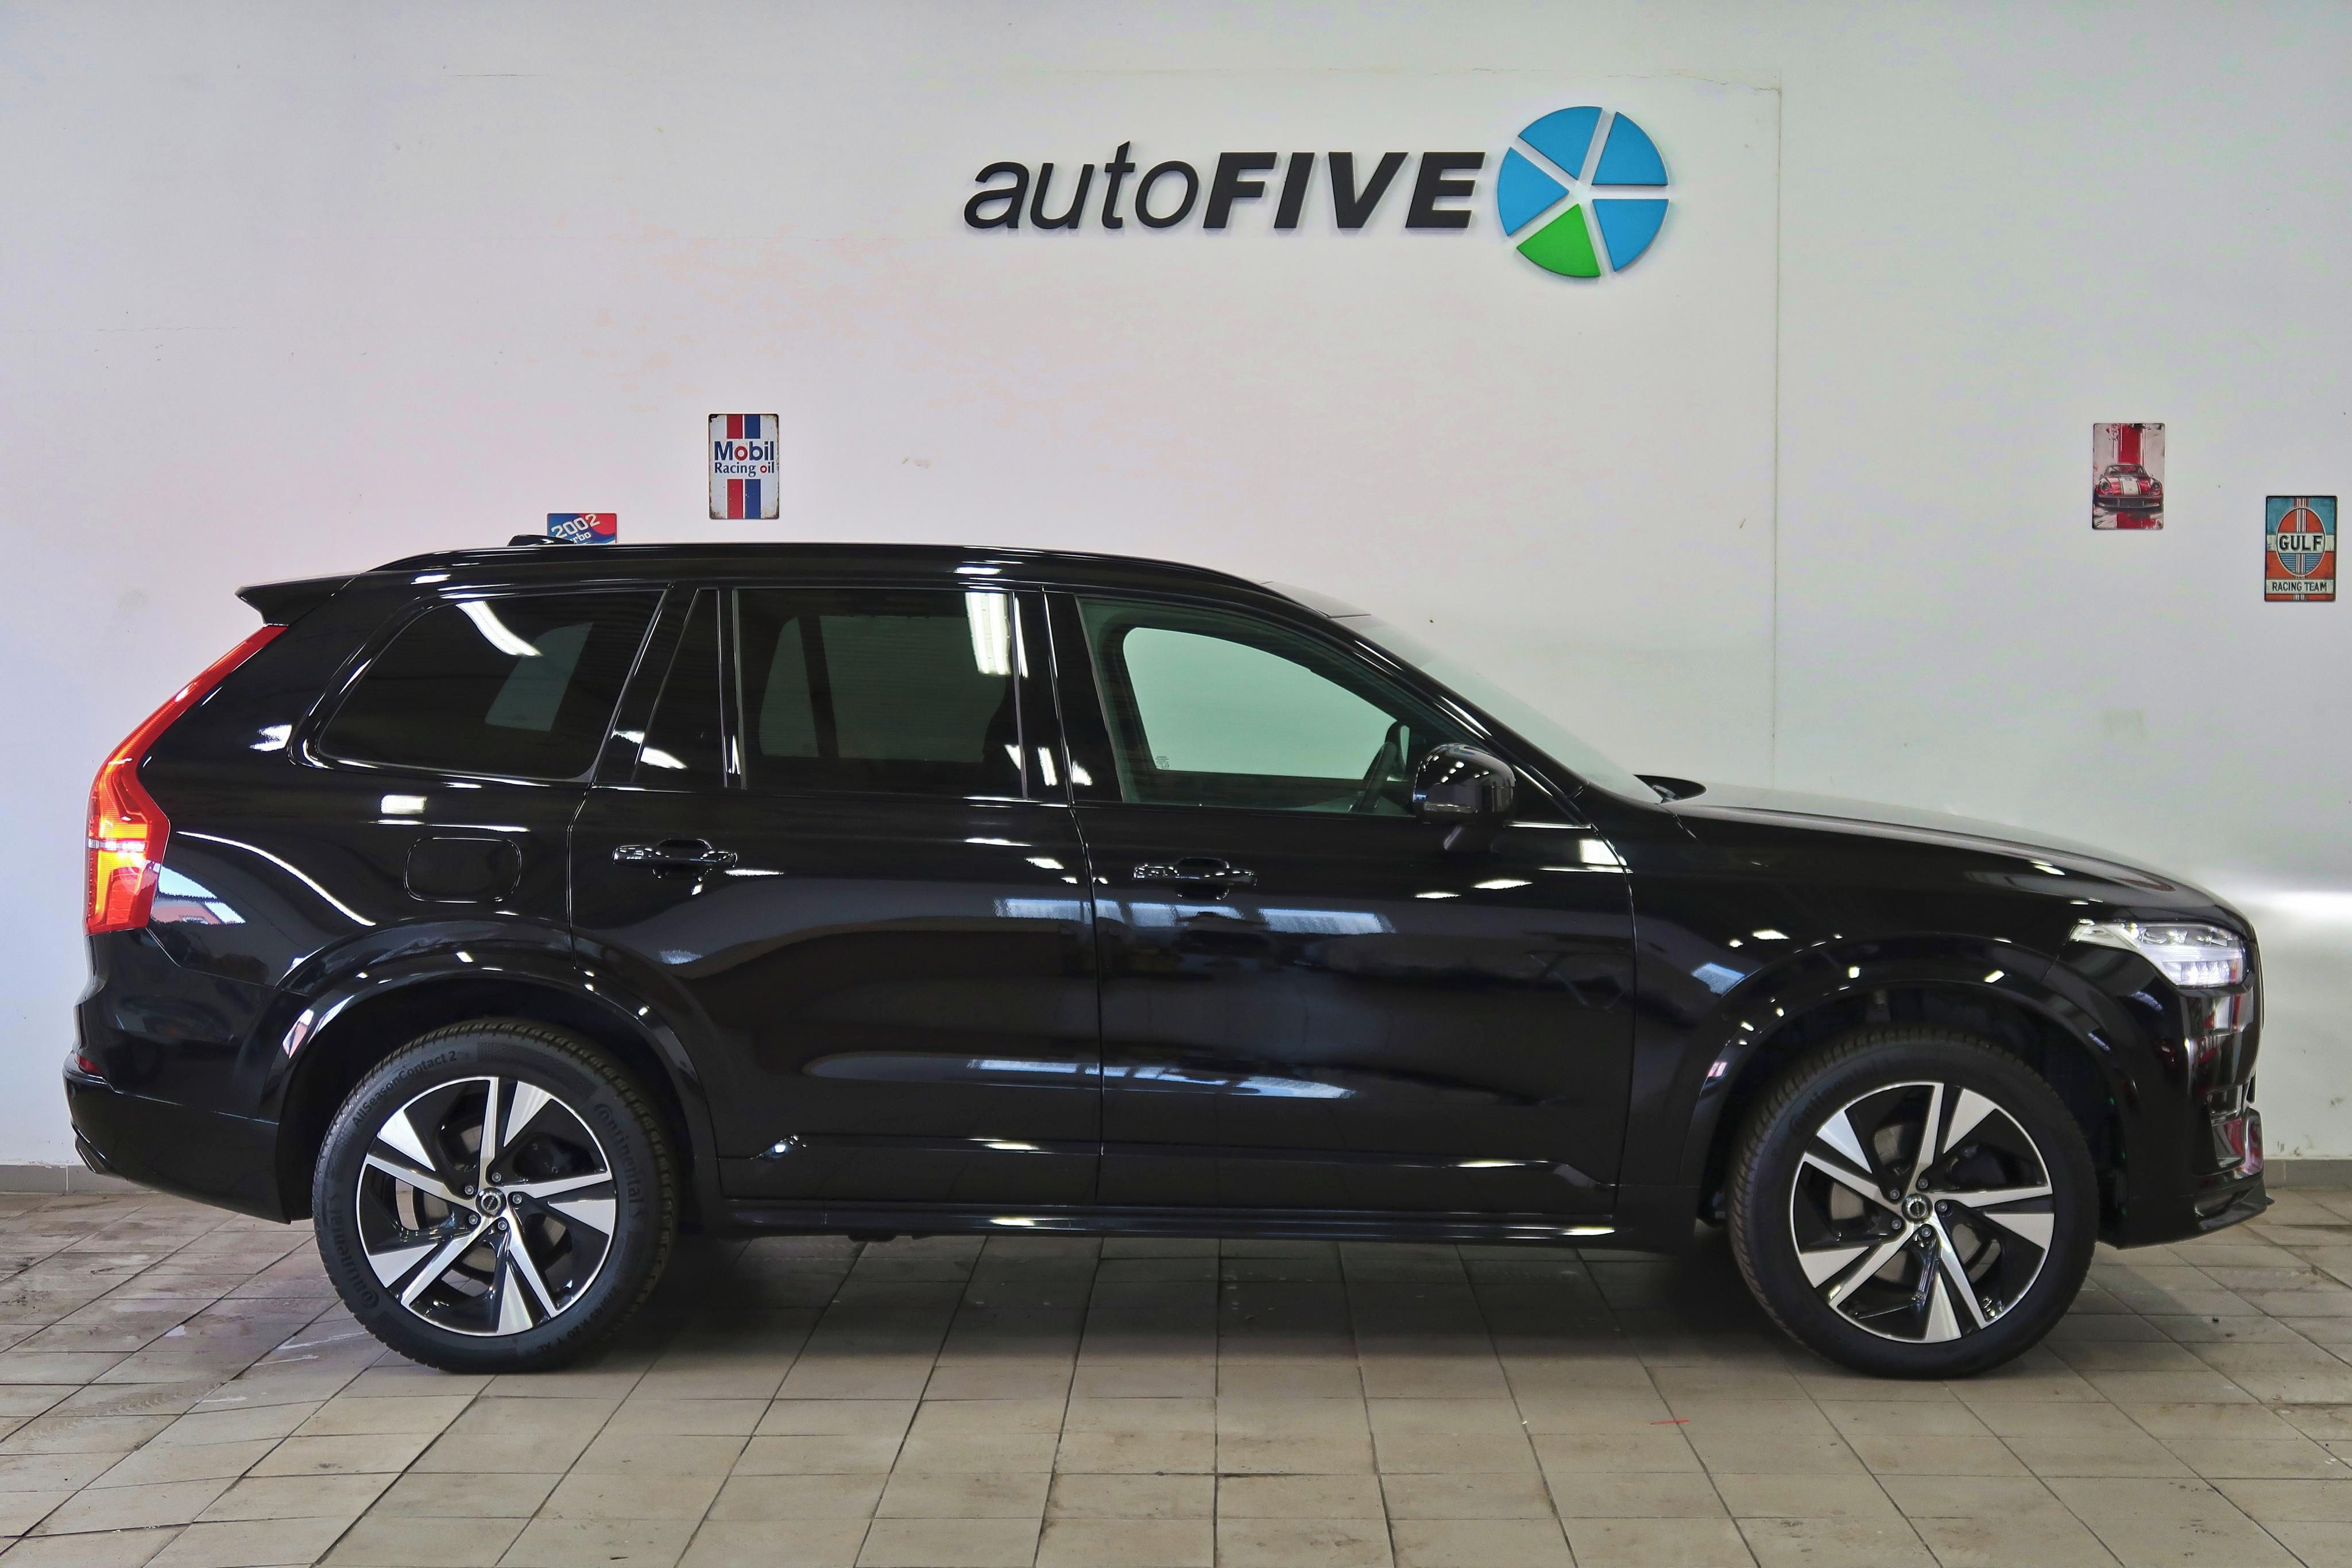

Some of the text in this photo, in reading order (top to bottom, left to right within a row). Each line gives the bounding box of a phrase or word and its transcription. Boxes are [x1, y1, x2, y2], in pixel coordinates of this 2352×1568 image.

[963, 141, 1486, 230] autoFIVE
[714, 441, 774, 461] Mobil
[714, 462, 775, 477] Racing oil
[551, 513, 600, 538] 2002
[2279, 535, 2323, 551] GULF
[2272, 582, 2327, 592] RACING TEAM
[448, 1050, 457, 1062] 2
[594, 1104, 644, 1204] Continental
